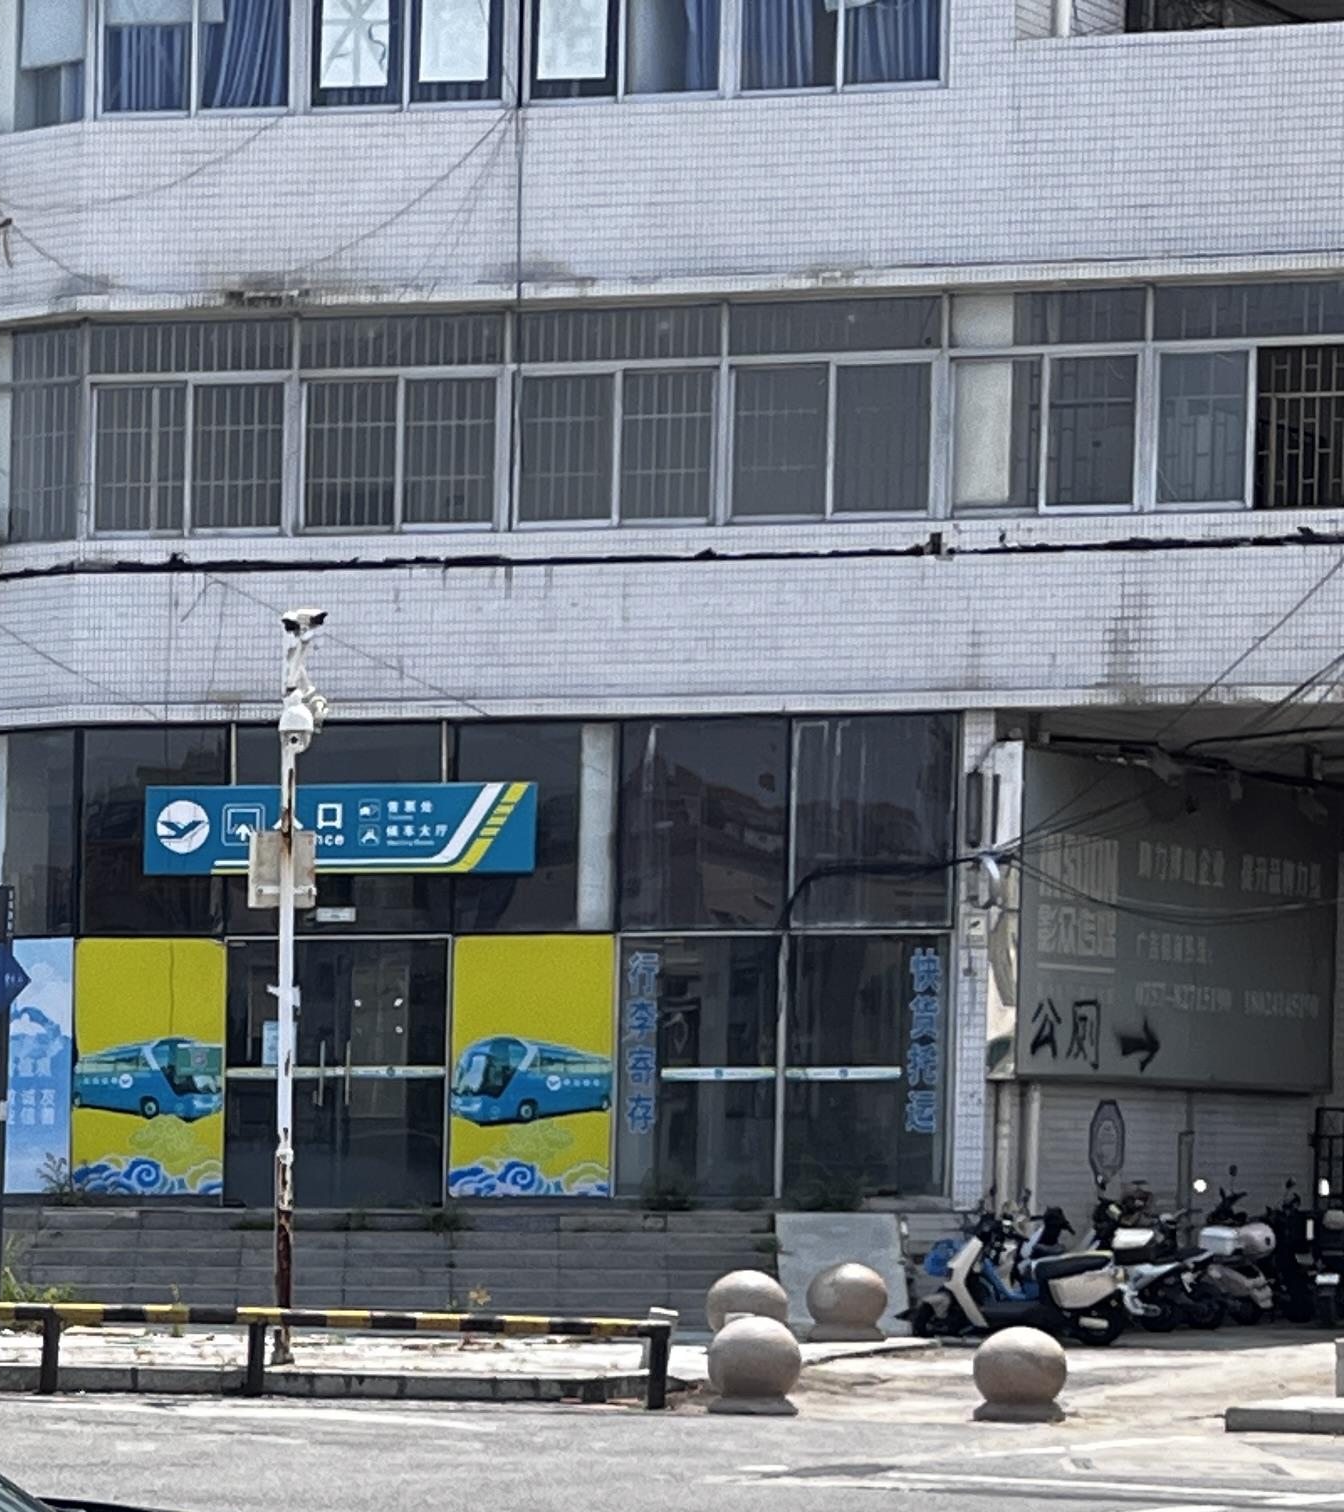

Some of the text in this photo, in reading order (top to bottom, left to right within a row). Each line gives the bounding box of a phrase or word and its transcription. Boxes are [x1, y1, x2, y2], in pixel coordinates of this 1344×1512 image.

[626, 950, 660, 1134] 行李寄存
[905, 946, 944, 1134] 快货托运
[1029, 994, 1102, 1071] 公厕
